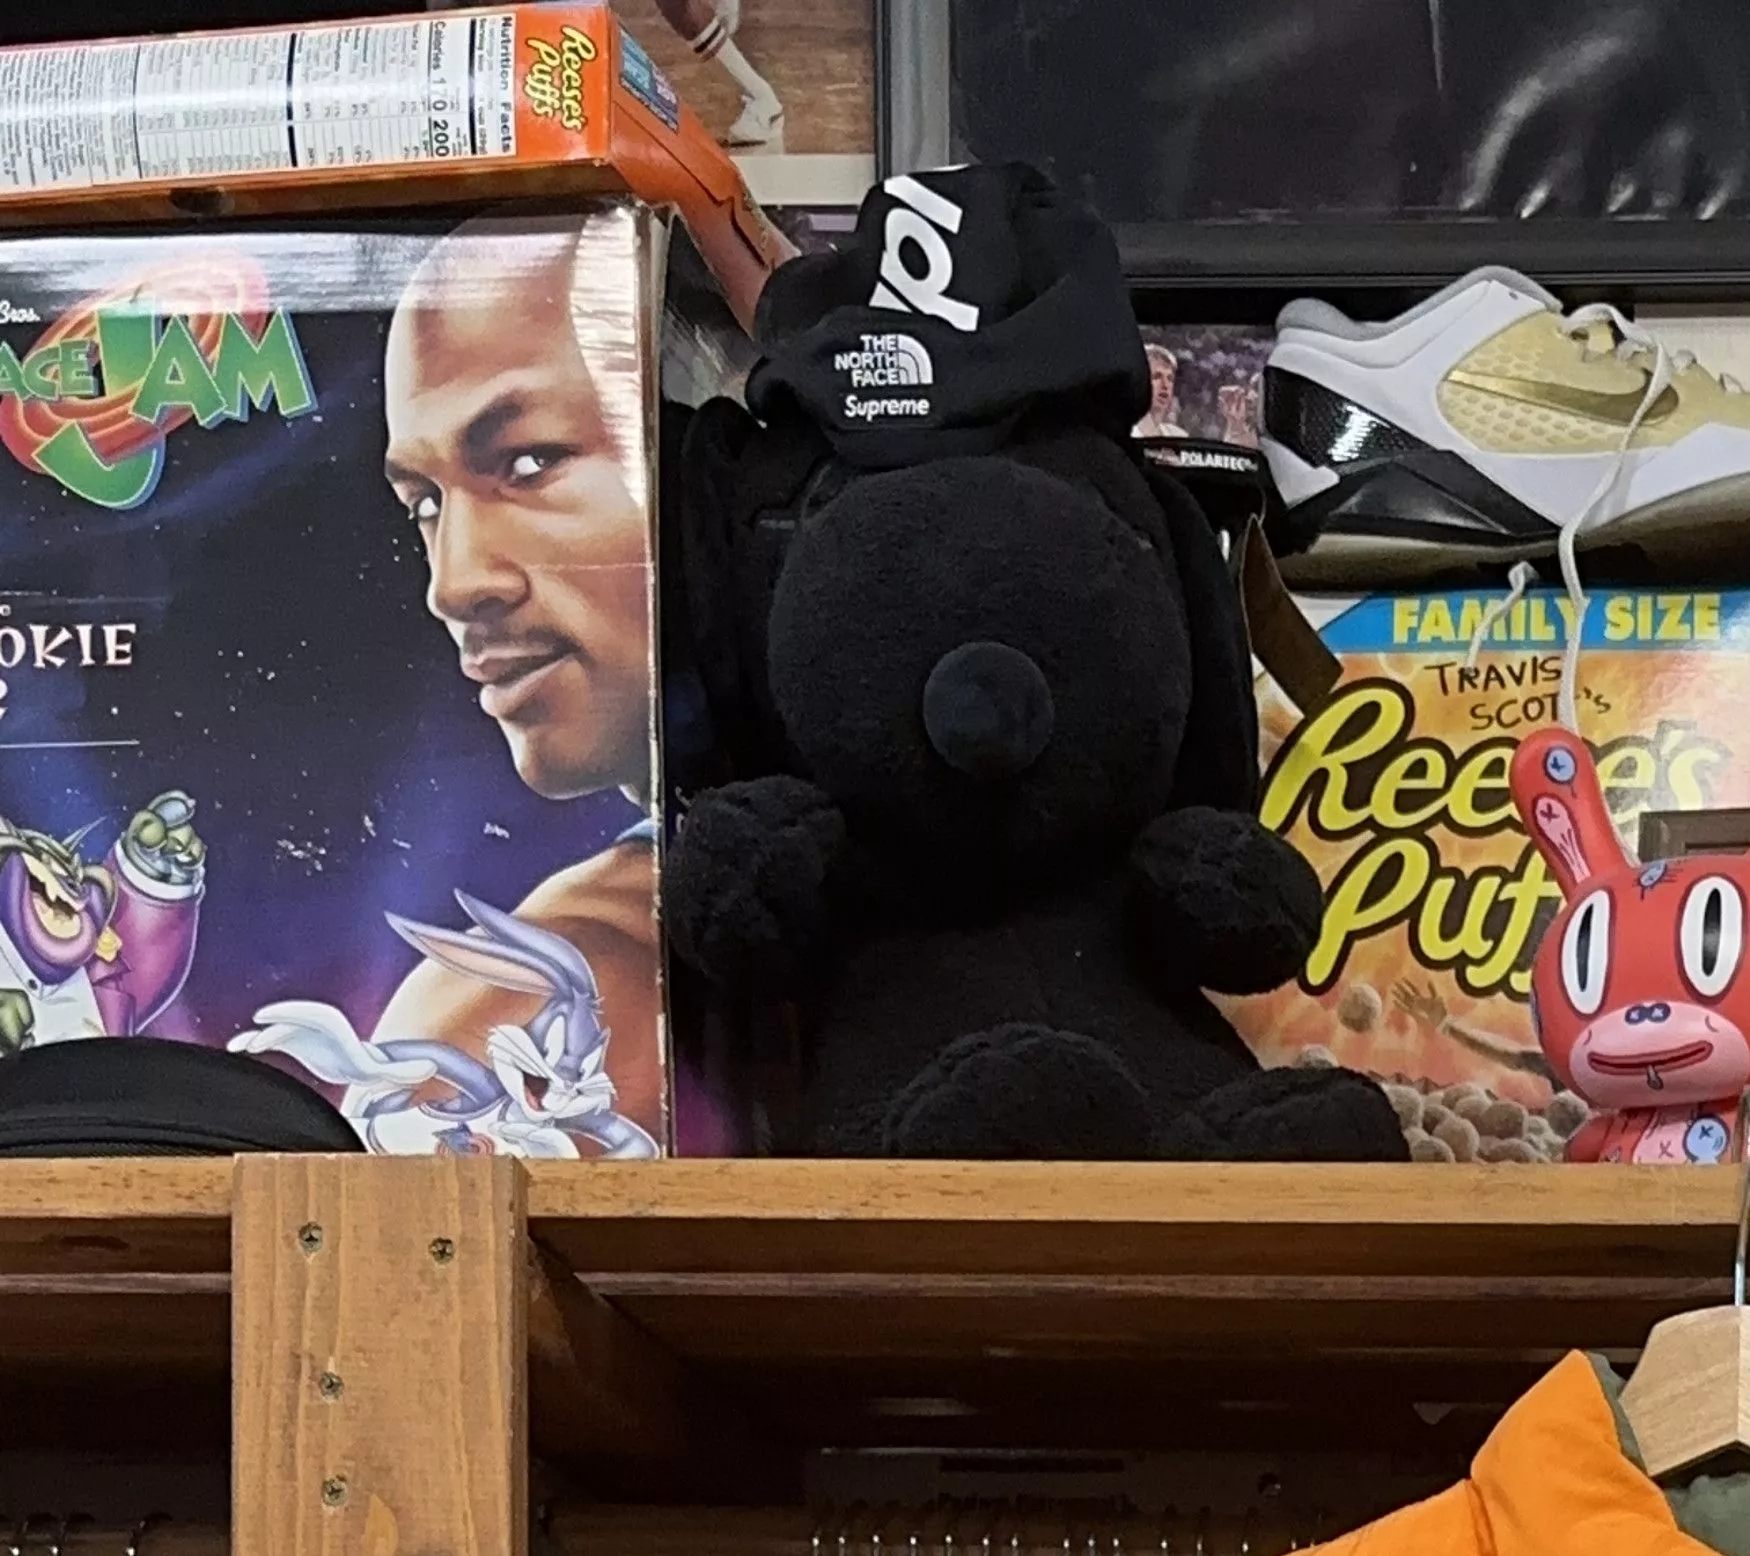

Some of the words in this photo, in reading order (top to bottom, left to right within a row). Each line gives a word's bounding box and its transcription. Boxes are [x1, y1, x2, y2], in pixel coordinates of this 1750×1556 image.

[500, 16, 513, 91] Nutrition
[523, 37, 561, 119] Puffs
[561, 26, 598, 132] Reese's
[432, 120, 450, 157] 200
[500, 102, 513, 153] Facts
[834, 351, 898, 370] NORTH
[859, 333, 898, 352] THE
[0, 340, 98, 401] ACE
[851, 368, 899, 388] FACE
[33, 299, 318, 510] JAM
[844, 394, 930, 421] Supreme
[1393, 596, 1591, 643] FAMILY
[1604, 594, 1722, 642] SIZE
[0, 622, 137, 670] OKIE
[1424, 655, 1563, 697] TRAVIS
[1469, 686, 1612, 731] SCOT'S
[1256, 686, 1722, 834] Reee's
